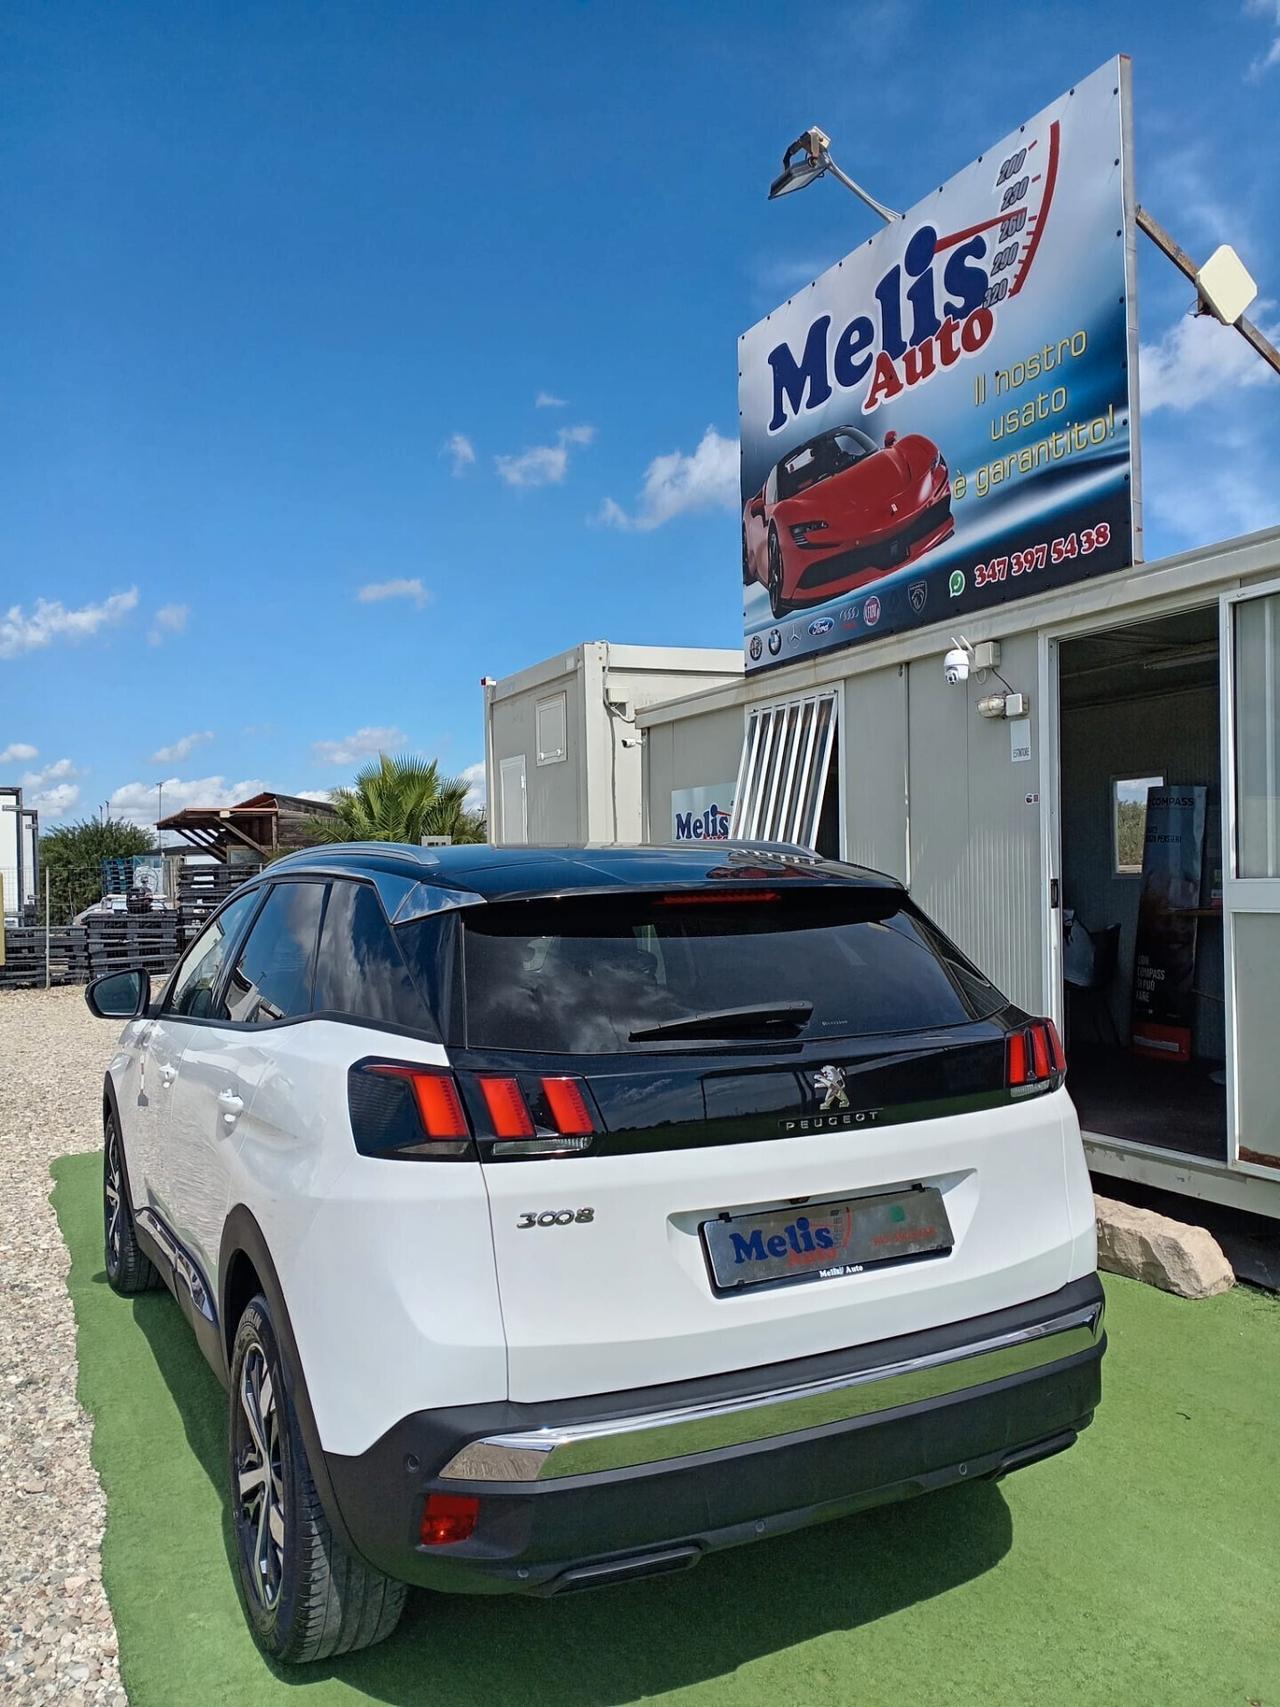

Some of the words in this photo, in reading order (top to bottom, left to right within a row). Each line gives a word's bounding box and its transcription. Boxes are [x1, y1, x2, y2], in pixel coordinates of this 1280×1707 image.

[996, 148, 1027, 187] 200
[1001, 176, 1029, 212] 230
[999, 208, 1027, 244] 260
[990, 242, 1019, 277] 290
[982, 278, 1008, 309] 320
[768, 226, 989, 431] Melis
[864, 307, 993, 410] Auto
[974, 374, 986, 406] Il
[994, 330, 1088, 395] nostro
[991, 386, 1068, 441] usato
[953, 469, 967, 500] è
[976, 403, 1115, 498] garantito!
[974, 556, 1009, 587] 347
[1011, 544, 1048, 575] 397
[1051, 533, 1078, 563] 54
[1080, 523, 1110, 554] 38
[676, 804, 729, 840] Melis
[786, 1111, 878, 1131] PEUGEOT
[516, 1207, 595, 1229] 3008
[729, 1217, 834, 1264] Melis
[846, 1264, 864, 1274] Auto
